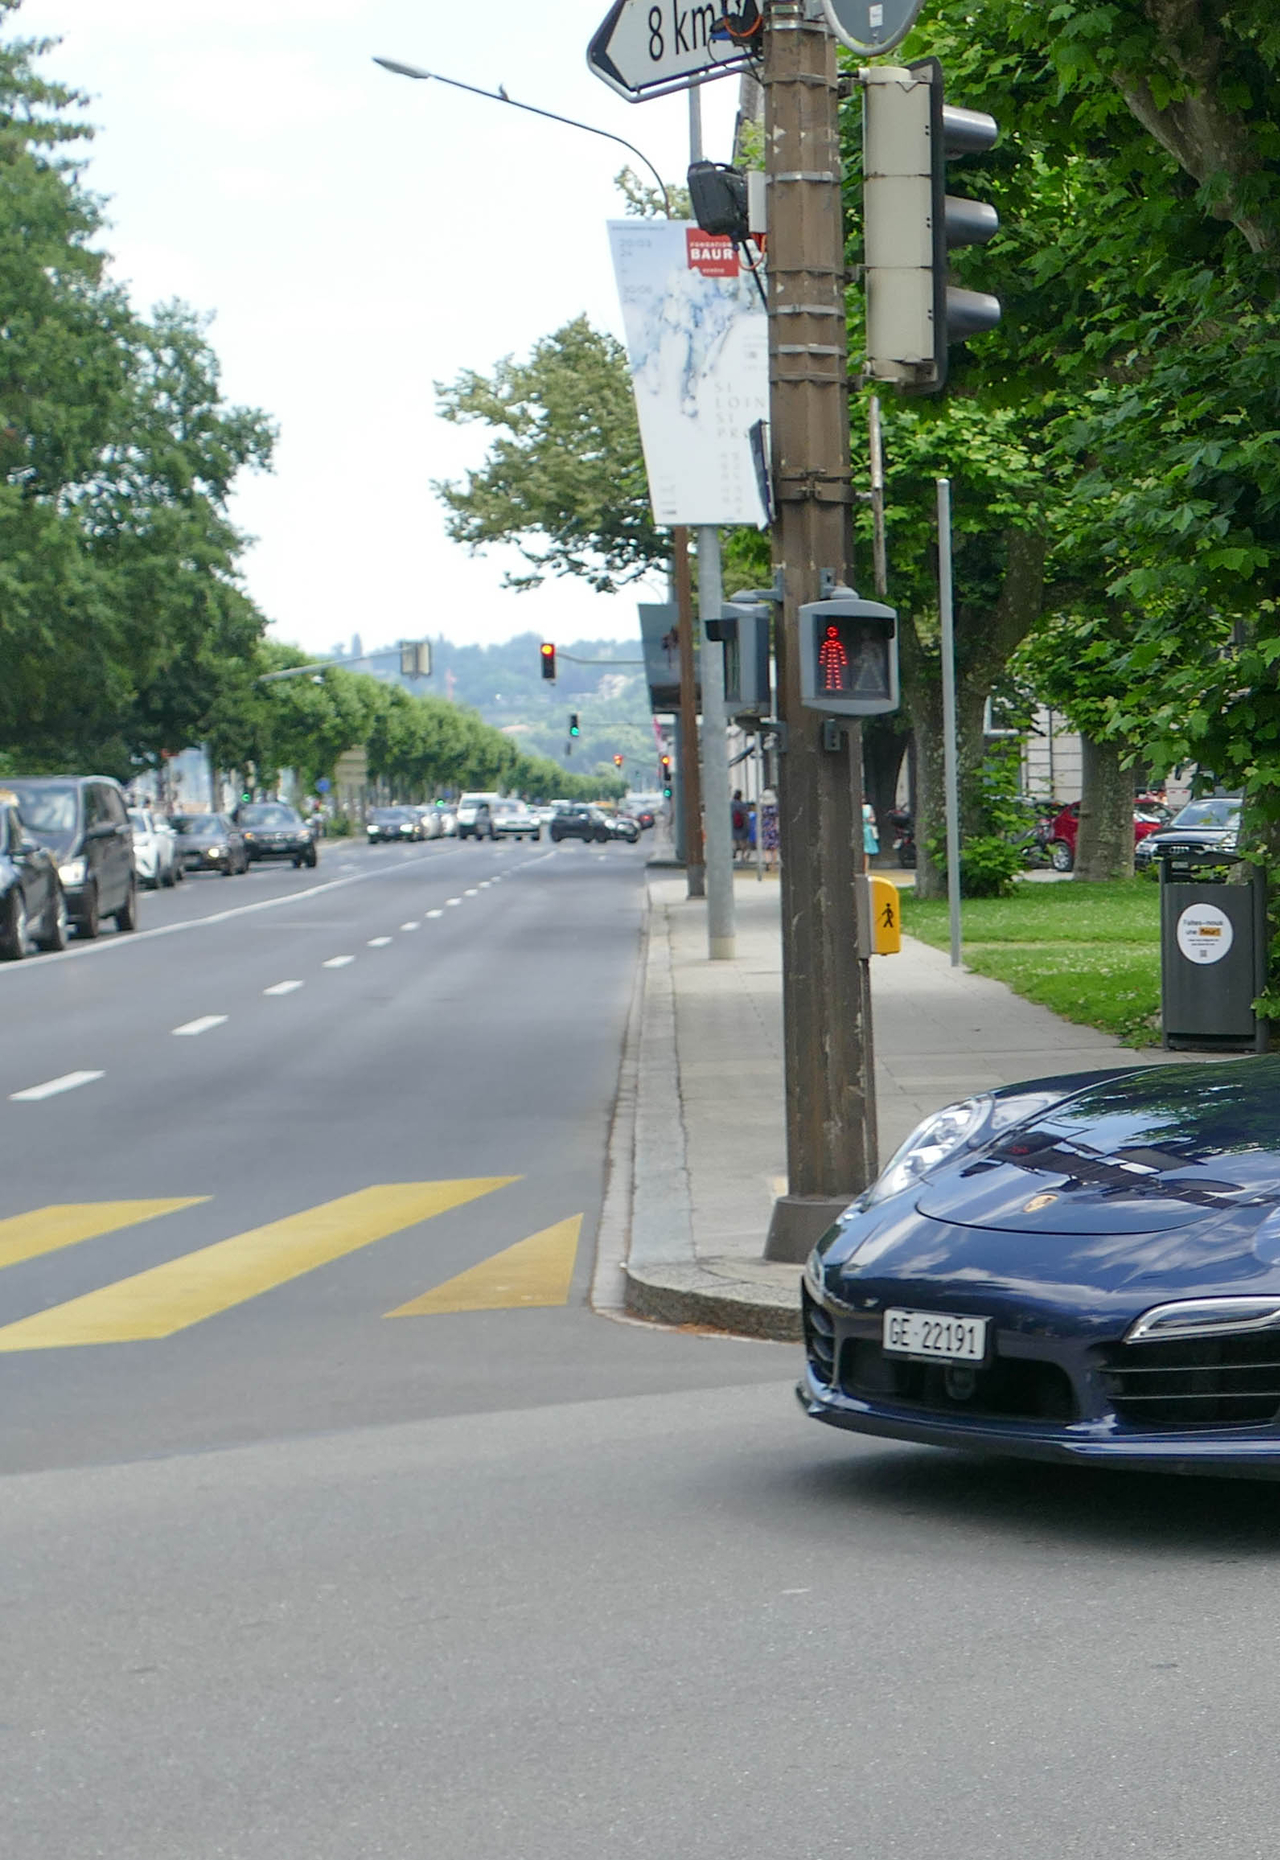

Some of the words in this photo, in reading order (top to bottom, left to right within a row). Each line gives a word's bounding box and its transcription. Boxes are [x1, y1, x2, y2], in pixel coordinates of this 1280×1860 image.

[649, 5, 664, 62] 8
[673, 0, 716, 55] km
[690, 248, 733, 260] BAUR
[715, 396, 765, 410] LOIN
[890, 1317, 910, 1346] GE
[922, 1321, 975, 1354] 22191
